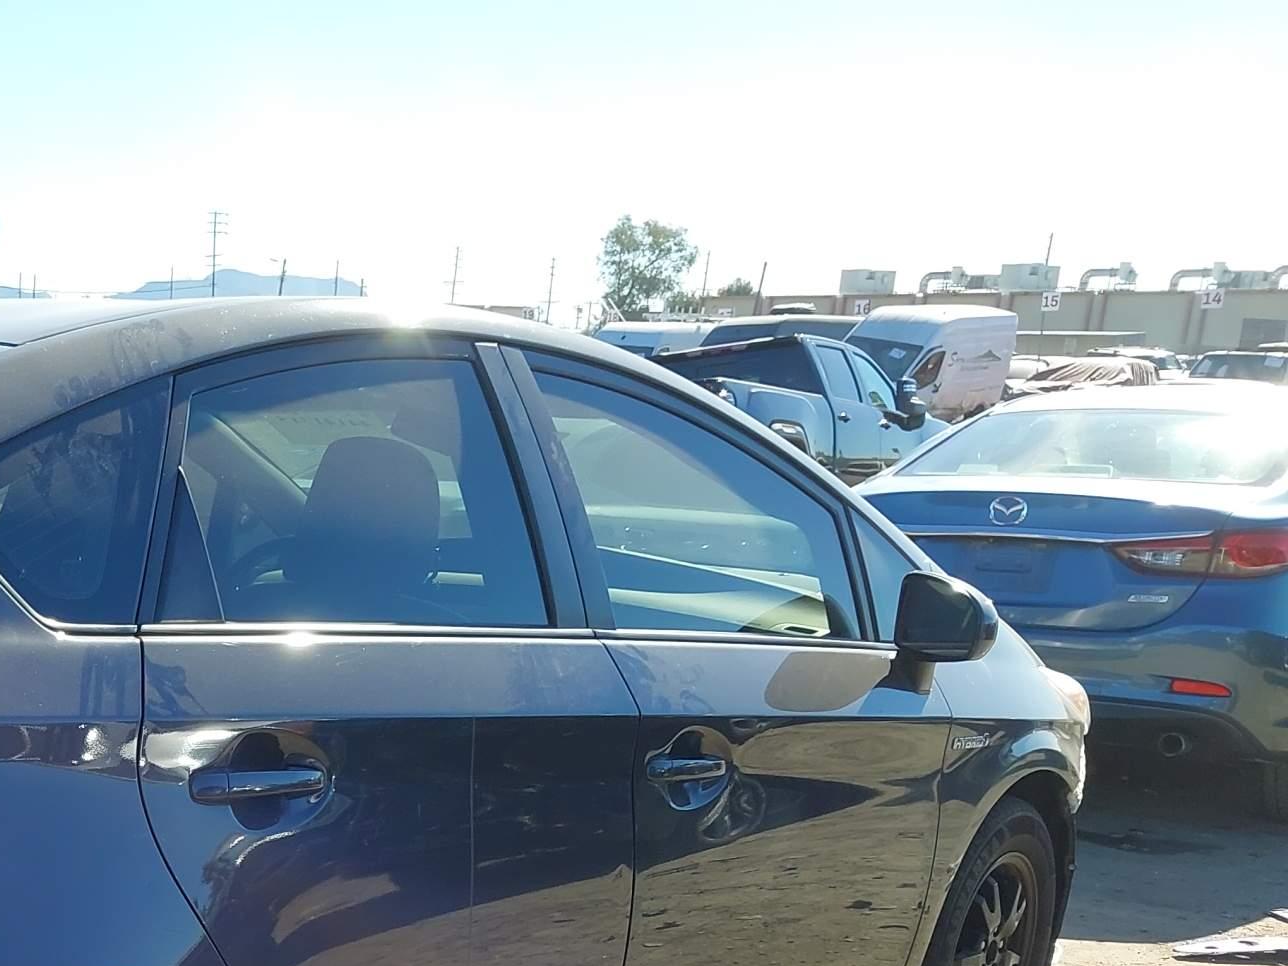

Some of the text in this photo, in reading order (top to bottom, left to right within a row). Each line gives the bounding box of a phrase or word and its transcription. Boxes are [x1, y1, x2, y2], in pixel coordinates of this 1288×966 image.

[1043, 295, 1059, 307] 15
[1202, 291, 1222, 305] 14
[856, 303, 871, 315] 16
